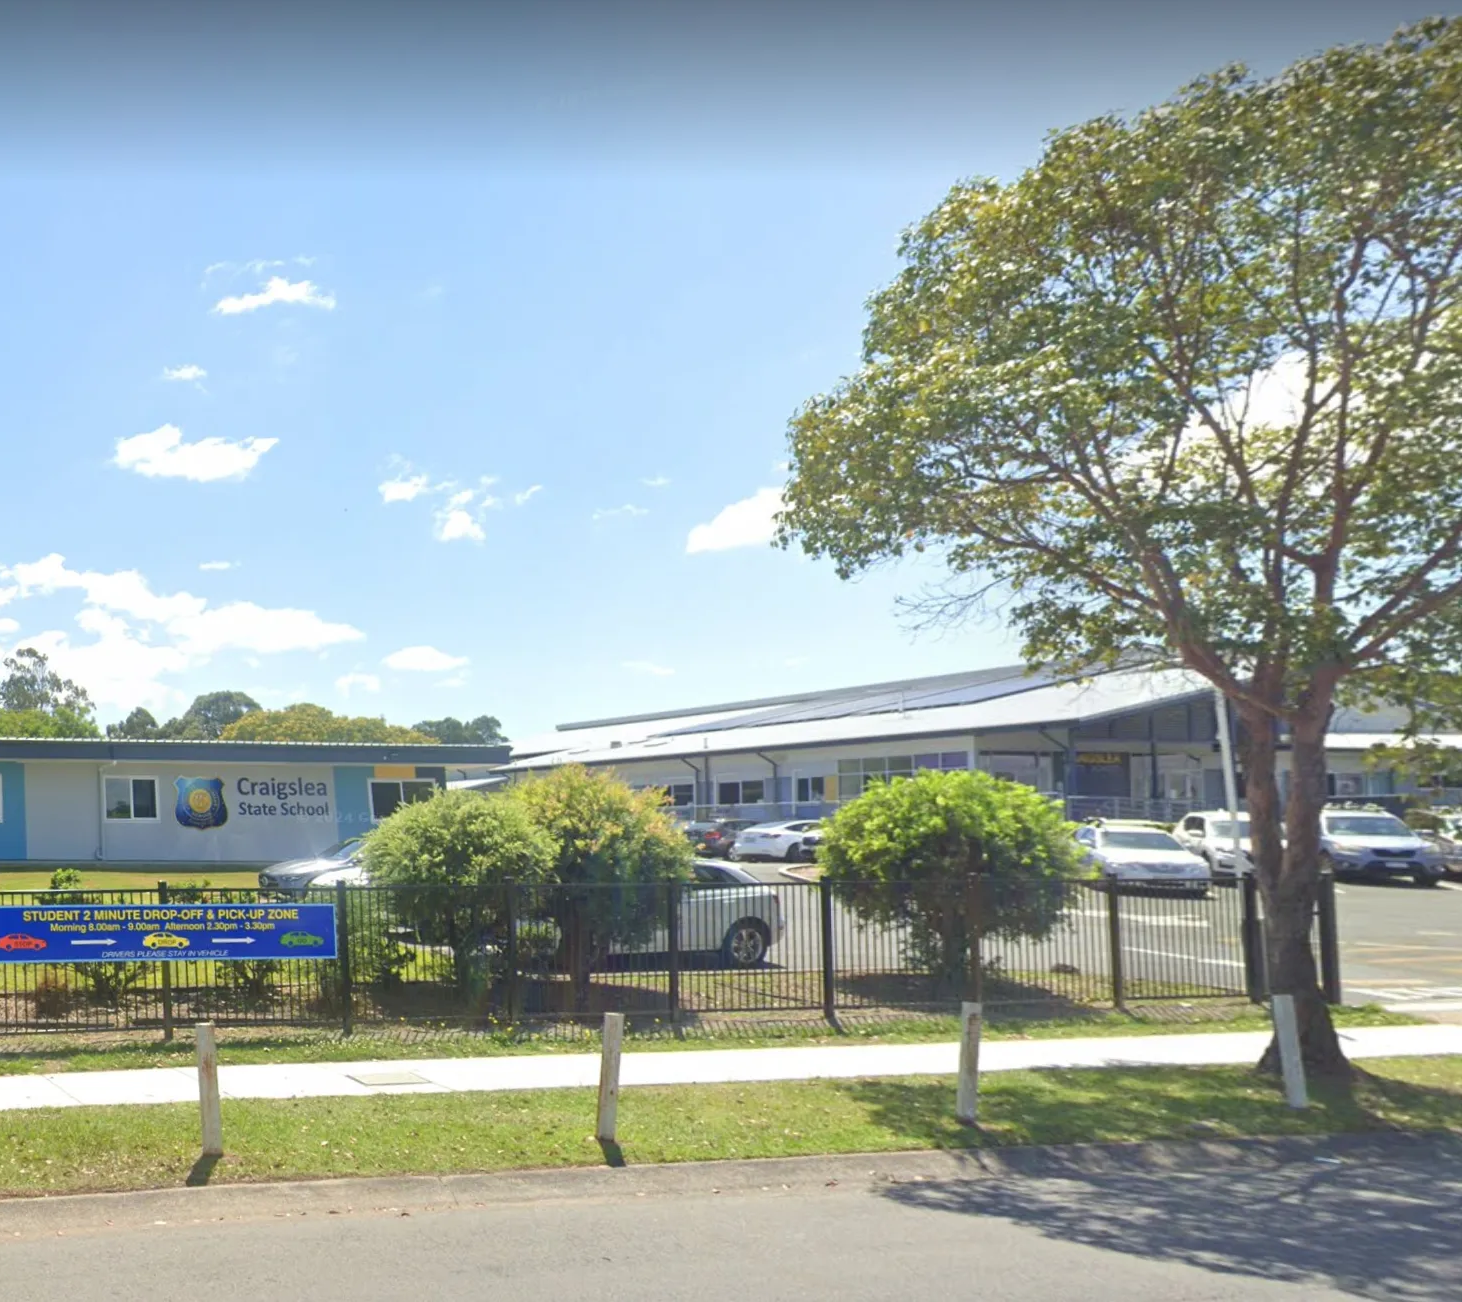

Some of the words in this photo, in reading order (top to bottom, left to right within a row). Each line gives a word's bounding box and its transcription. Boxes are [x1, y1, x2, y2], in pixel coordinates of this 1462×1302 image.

[237, 777, 328, 800] Craigslea
[238, 802, 277, 815] State
[280, 802, 329, 816] School
[23, 910, 80, 921] STUDENT
[83, 910, 91, 921] 2
[94, 910, 140, 920] MINUTE
[143, 909, 203, 920] DROP-OFF
[206, 909, 214, 920] &
[218, 909, 265, 920] PICK-UP
[267, 908, 298, 919] ZONE
[50, 923, 87, 933] Morning
[88, 923, 120, 932] 8.00am
[128, 922, 160, 931] 9.00am
[165, 922, 205, 931] Afternoon
[206, 922, 238, 932] 2.30pm
[245, 921, 275, 931] 3.30pm
[137, 950, 167, 958] PLEASE
[167, 949, 187, 957] STAY
[188, 949, 195, 957] IN
[196, 949, 229, 957] VEHICLE
